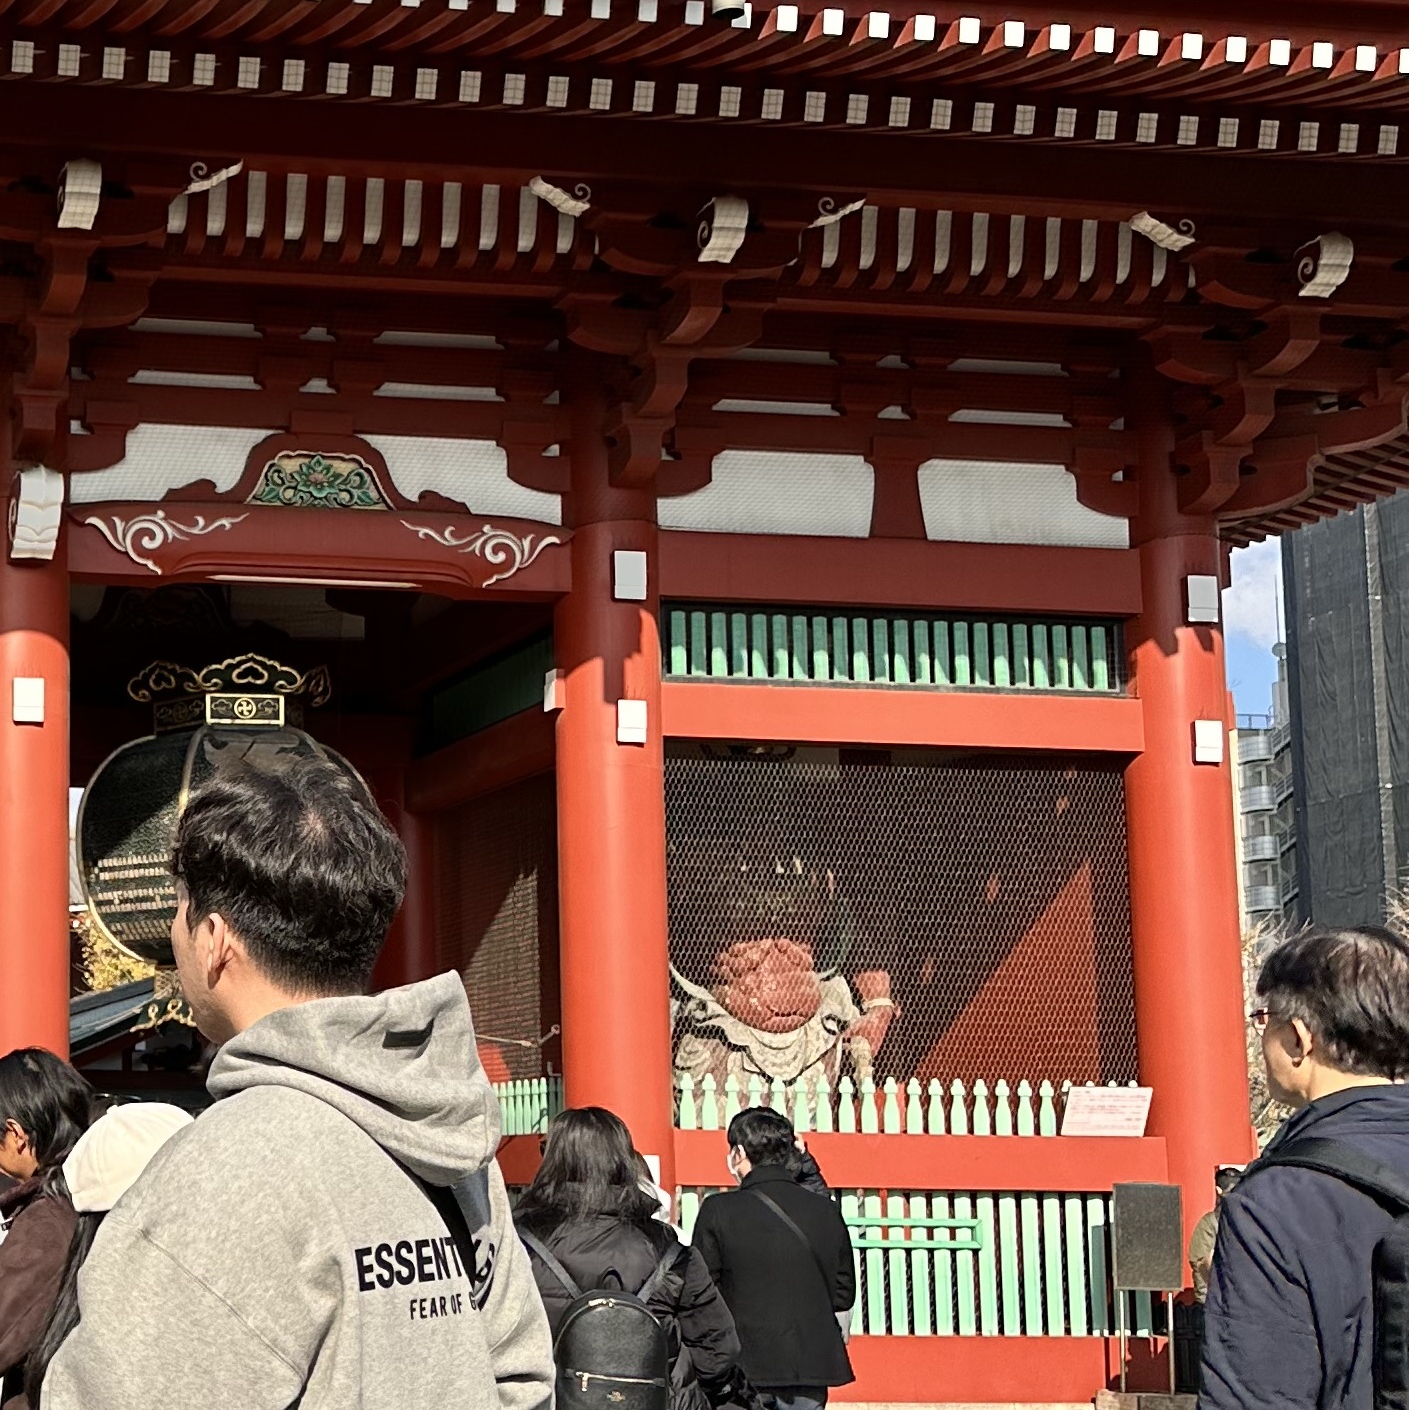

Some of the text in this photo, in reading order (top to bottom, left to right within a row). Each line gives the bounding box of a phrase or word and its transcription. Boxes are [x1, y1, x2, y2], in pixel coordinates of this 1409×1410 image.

[354, 1237, 494, 1292] ESSENT
[409, 1295, 448, 1320] FEAR
[451, 1293, 462, 1315] OF
